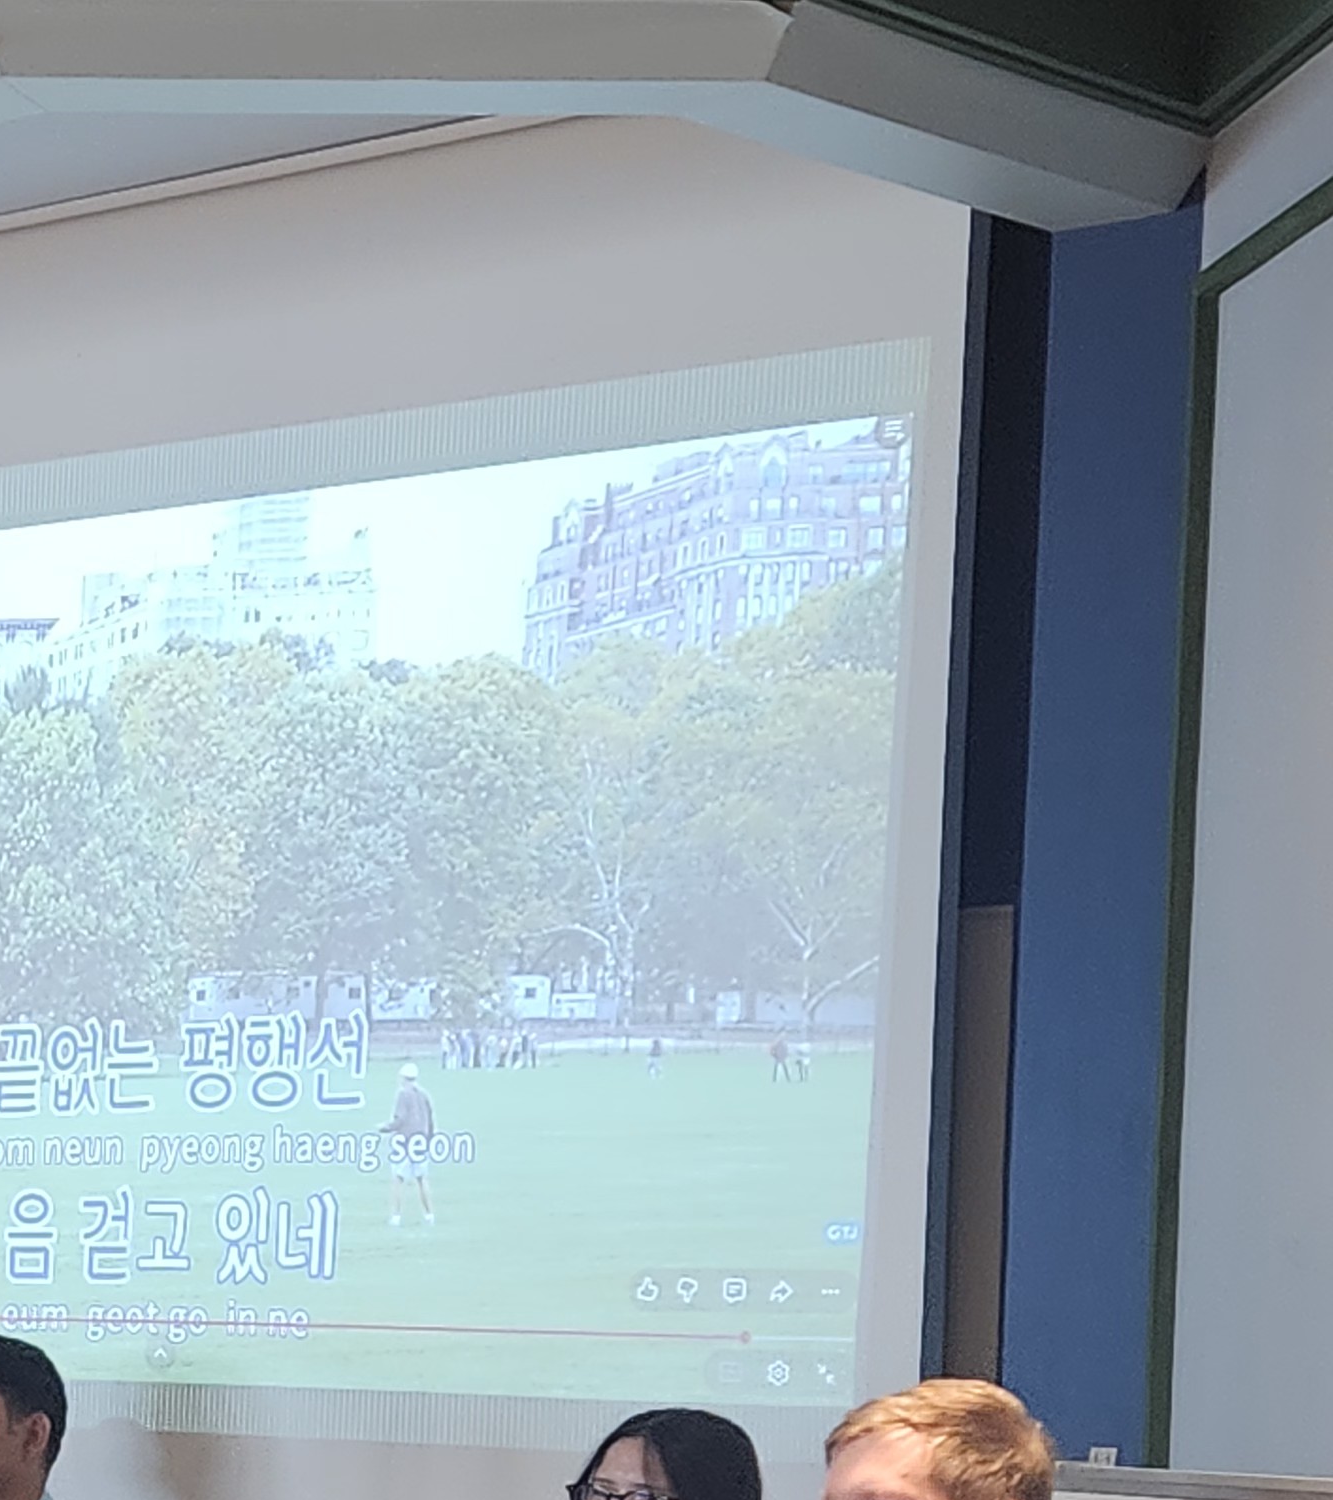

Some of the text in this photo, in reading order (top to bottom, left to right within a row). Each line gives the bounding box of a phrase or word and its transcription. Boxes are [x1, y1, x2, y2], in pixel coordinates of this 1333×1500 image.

[179, 1008, 369, 1112] 평행선
[42, 1134, 125, 1166] neun
[139, 1133, 265, 1174] pyeong
[271, 1123, 382, 1173] haeng
[386, 1131, 477, 1165] seon
[4, 1184, 340, 1286] 음 걷고 있네
[0, 1299, 311, 1343] eum geot go in ne
